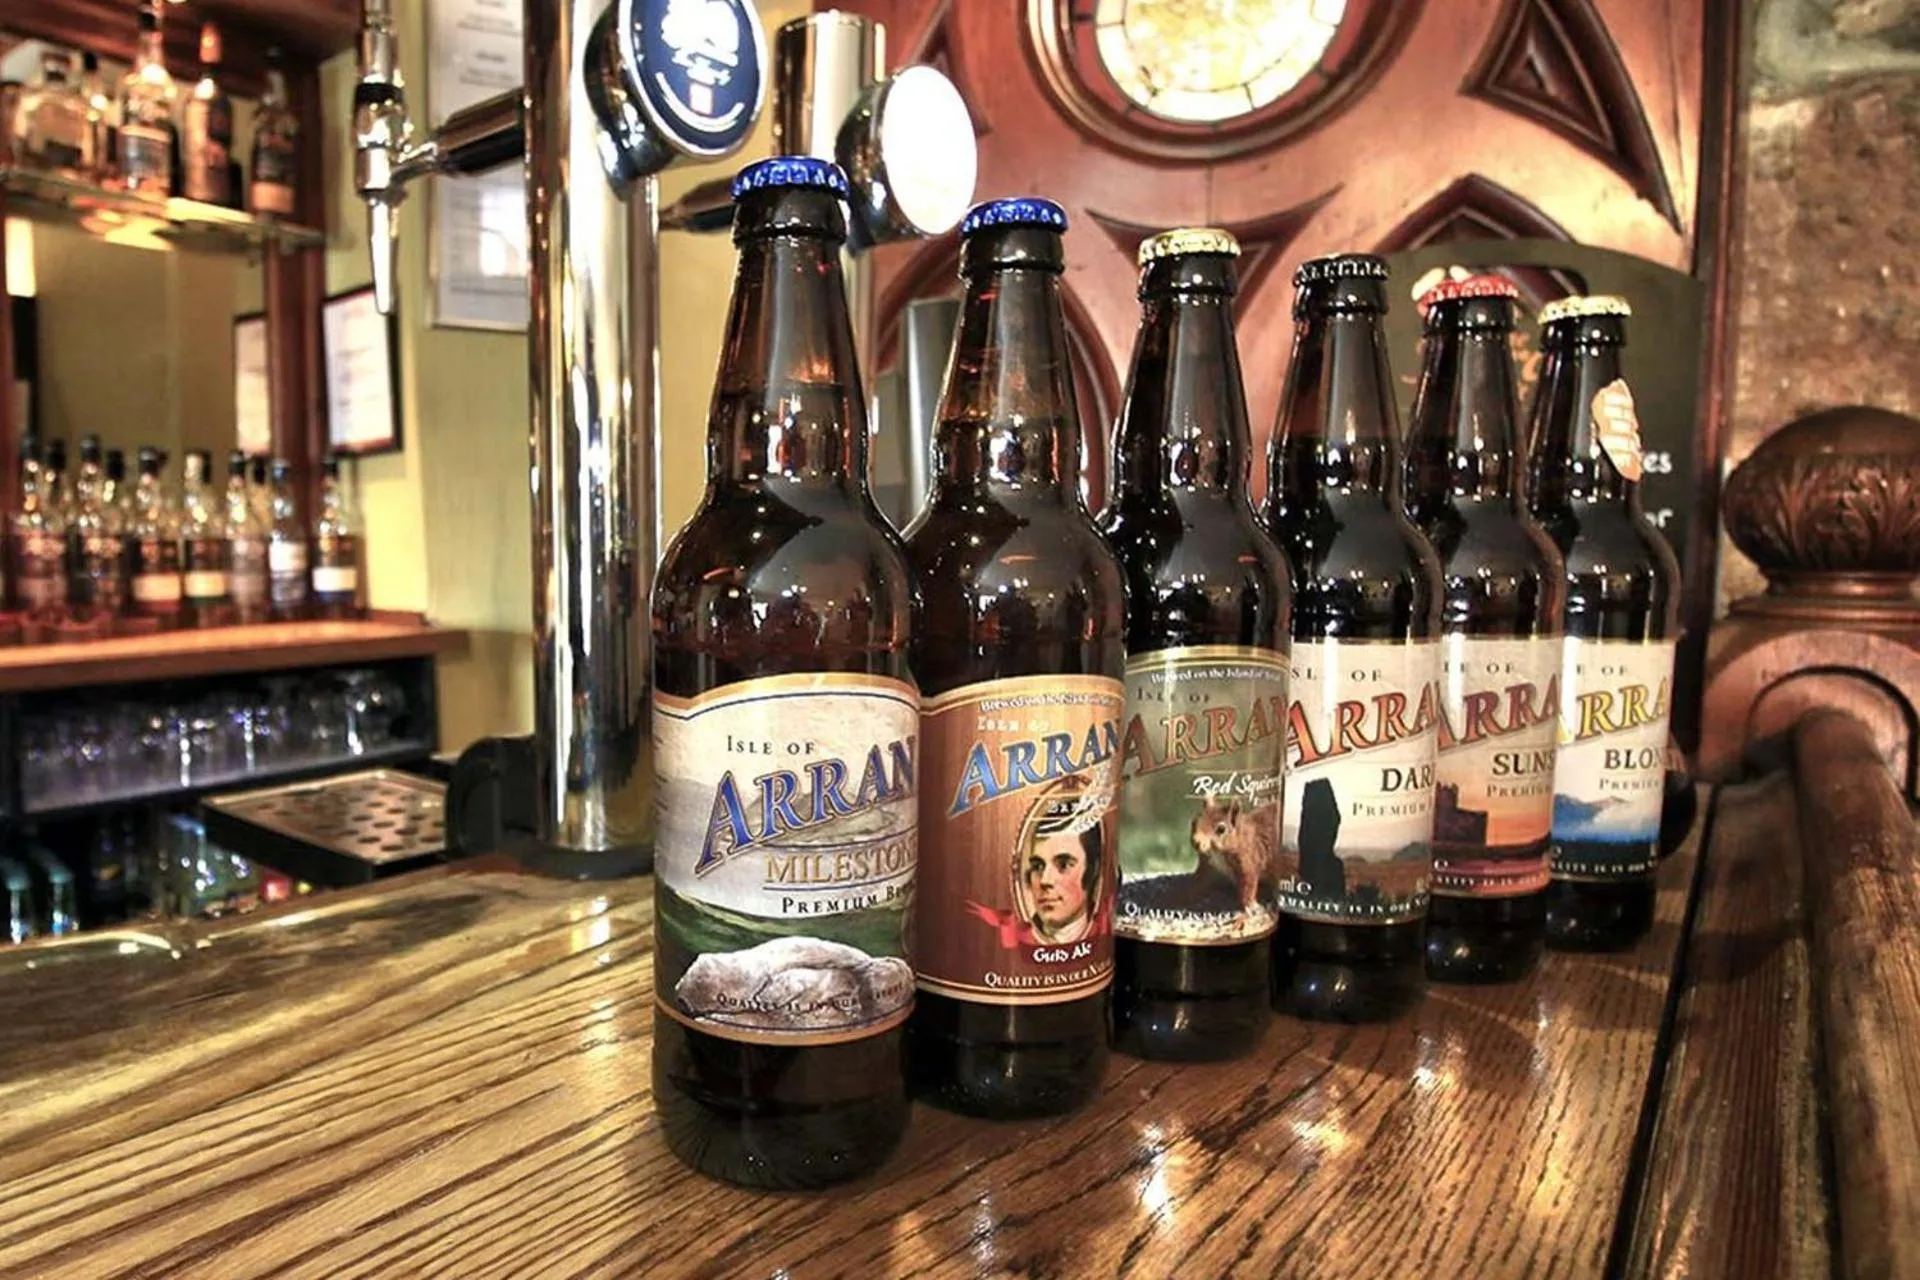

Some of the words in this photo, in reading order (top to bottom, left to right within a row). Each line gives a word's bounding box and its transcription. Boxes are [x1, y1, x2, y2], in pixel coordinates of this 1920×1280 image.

[1351, 669, 1382, 682] OF
[1286, 680, 1440, 769] ARRA
[727, 735, 773, 755] ISLE
[787, 742, 816, 756] OF
[1192, 770, 1238, 797] Red
[1380, 762, 1436, 792] DAR
[695, 735, 917, 878] ARRAN
[764, 838, 918, 884] MILESTON
[782, 894, 879, 914] PREMIUM
[984, 970, 1041, 988] QUALITY
